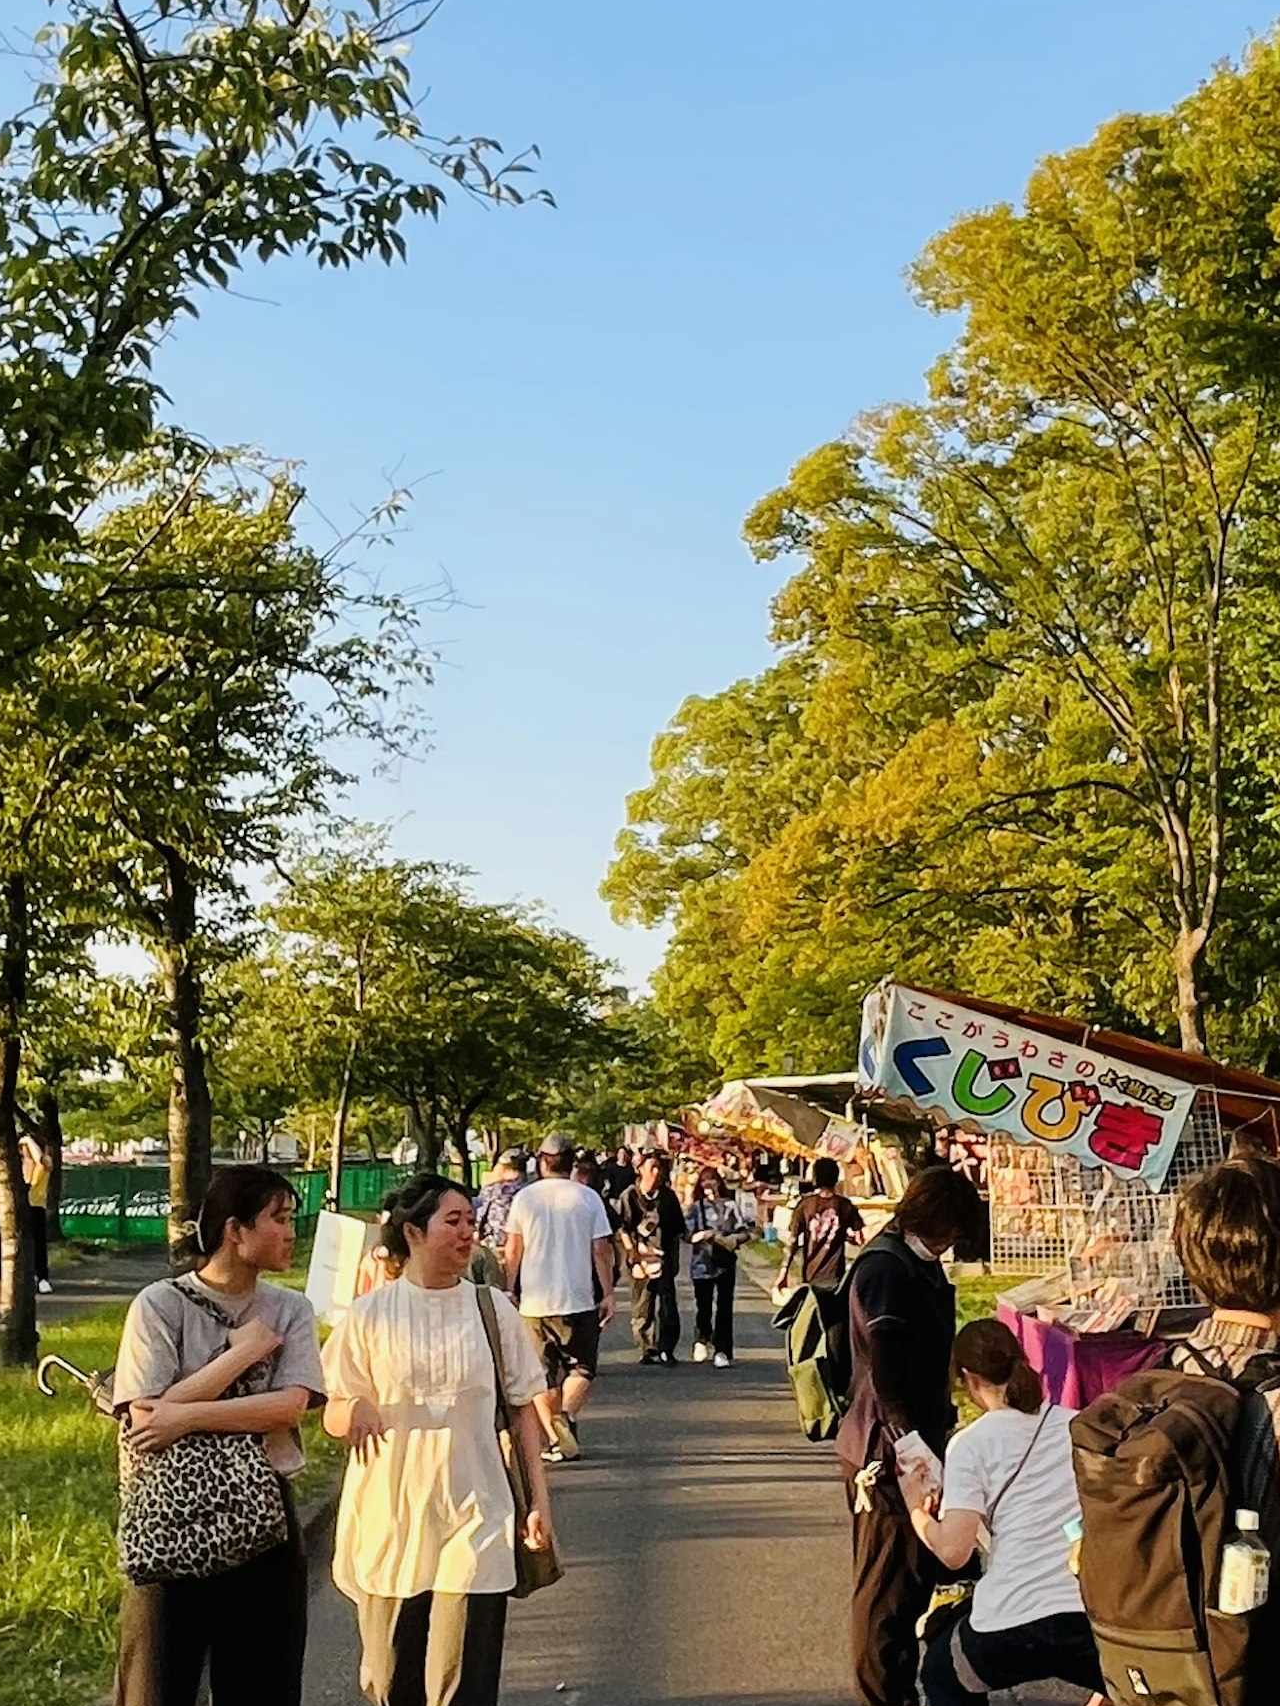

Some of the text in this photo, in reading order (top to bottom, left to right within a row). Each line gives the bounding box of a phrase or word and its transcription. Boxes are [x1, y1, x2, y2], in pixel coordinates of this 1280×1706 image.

[907, 1000, 1096, 1078] ここがうわさの
[893, 1036, 1166, 1171] くじびき
[1098, 1067, 1177, 1112] よく当たる
